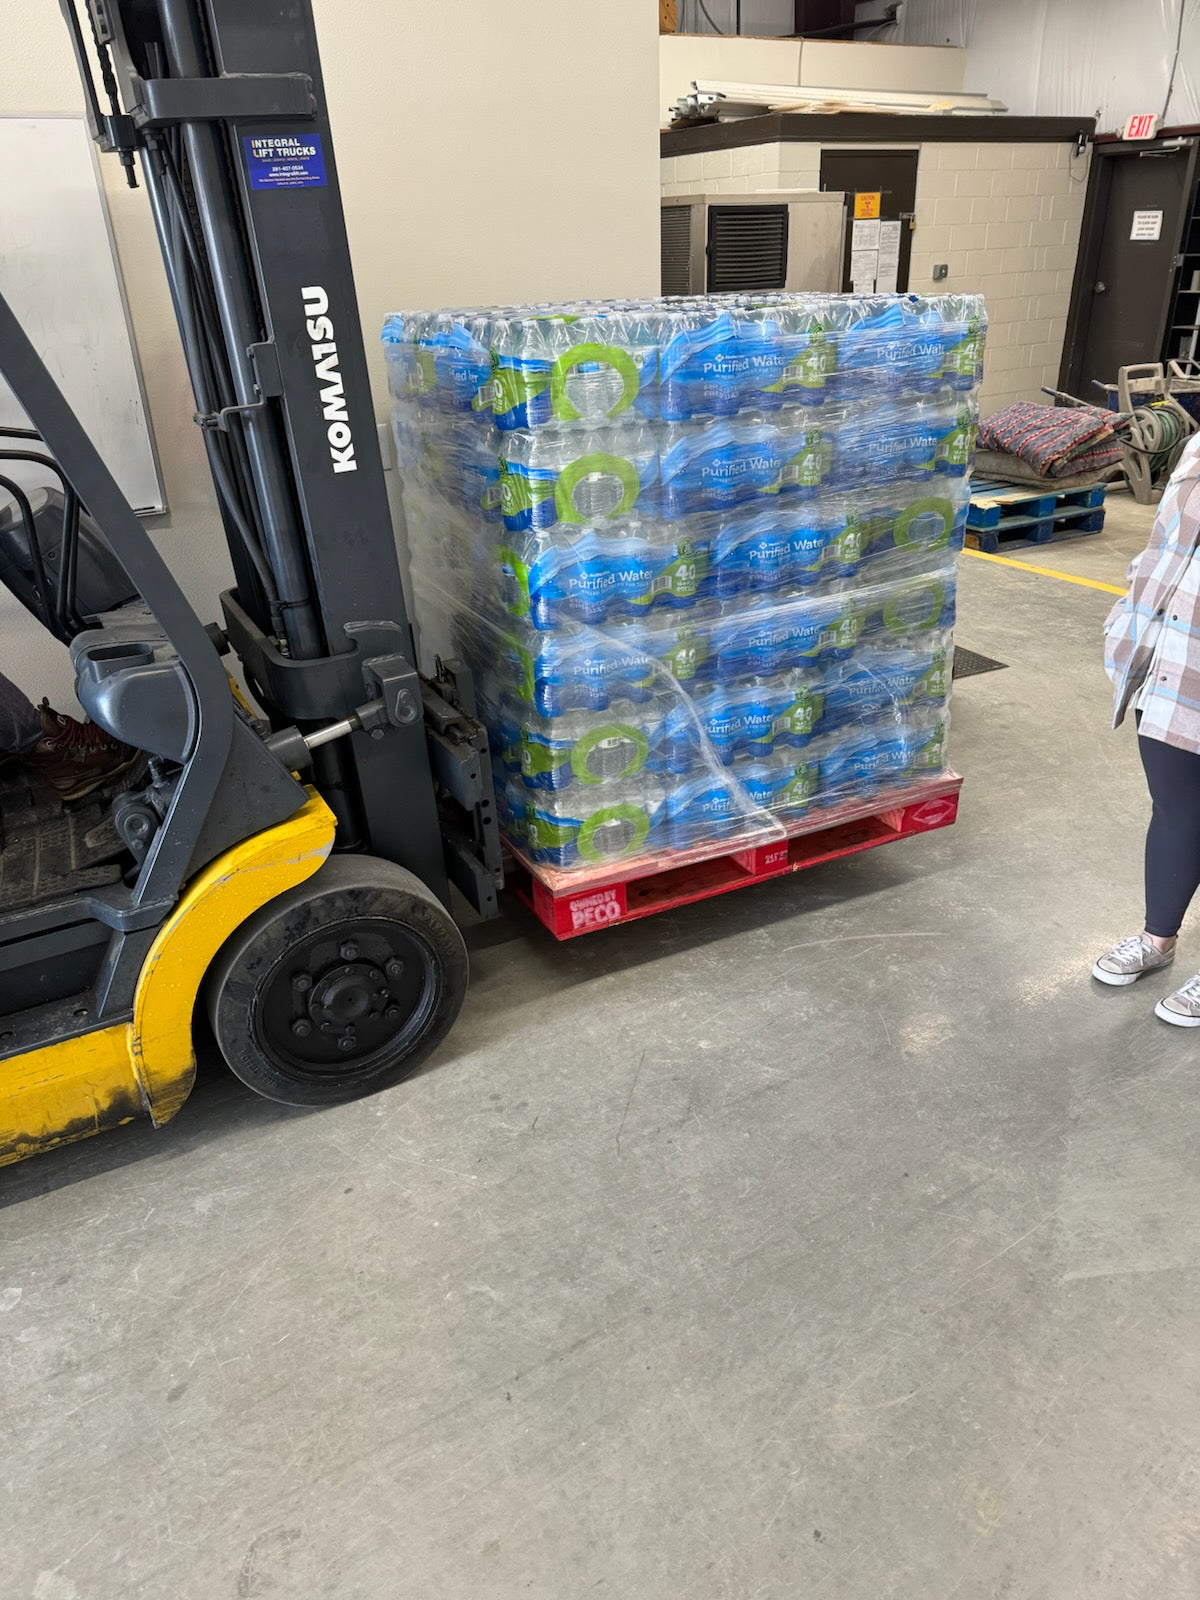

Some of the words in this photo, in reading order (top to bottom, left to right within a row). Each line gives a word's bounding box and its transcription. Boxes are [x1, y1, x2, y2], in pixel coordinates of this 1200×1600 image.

[1128, 115, 1154, 137] EXIT
[251, 138, 300, 148] INTEGRAL
[252, 148, 273, 158] LIFT
[276, 146, 316, 157] TRUCKS
[919, 344, 945, 355] Wat
[703, 358, 749, 373] Purified
[752, 355, 785, 367] Wate
[806, 352, 826, 371] 40
[301, 285, 357, 473] KOMATSU
[910, 436, 938, 447] Wate
[802, 453, 822, 470] 40
[702, 462, 746, 477] Purified
[749, 544, 791, 560] Purified
[675, 564, 696, 580] 40
[569, 574, 615, 590] Purified
[619, 570, 653, 582] Water
[792, 627, 820, 638] Wate
[840, 619, 857, 634] 40
[621, 655, 650, 667] Wate
[675, 649, 696, 664] 40
[889, 676, 917, 686] Wate
[794, 706, 813, 721] 40
[892, 750, 915, 761] Wate
[572, 901, 621, 928] PECO
